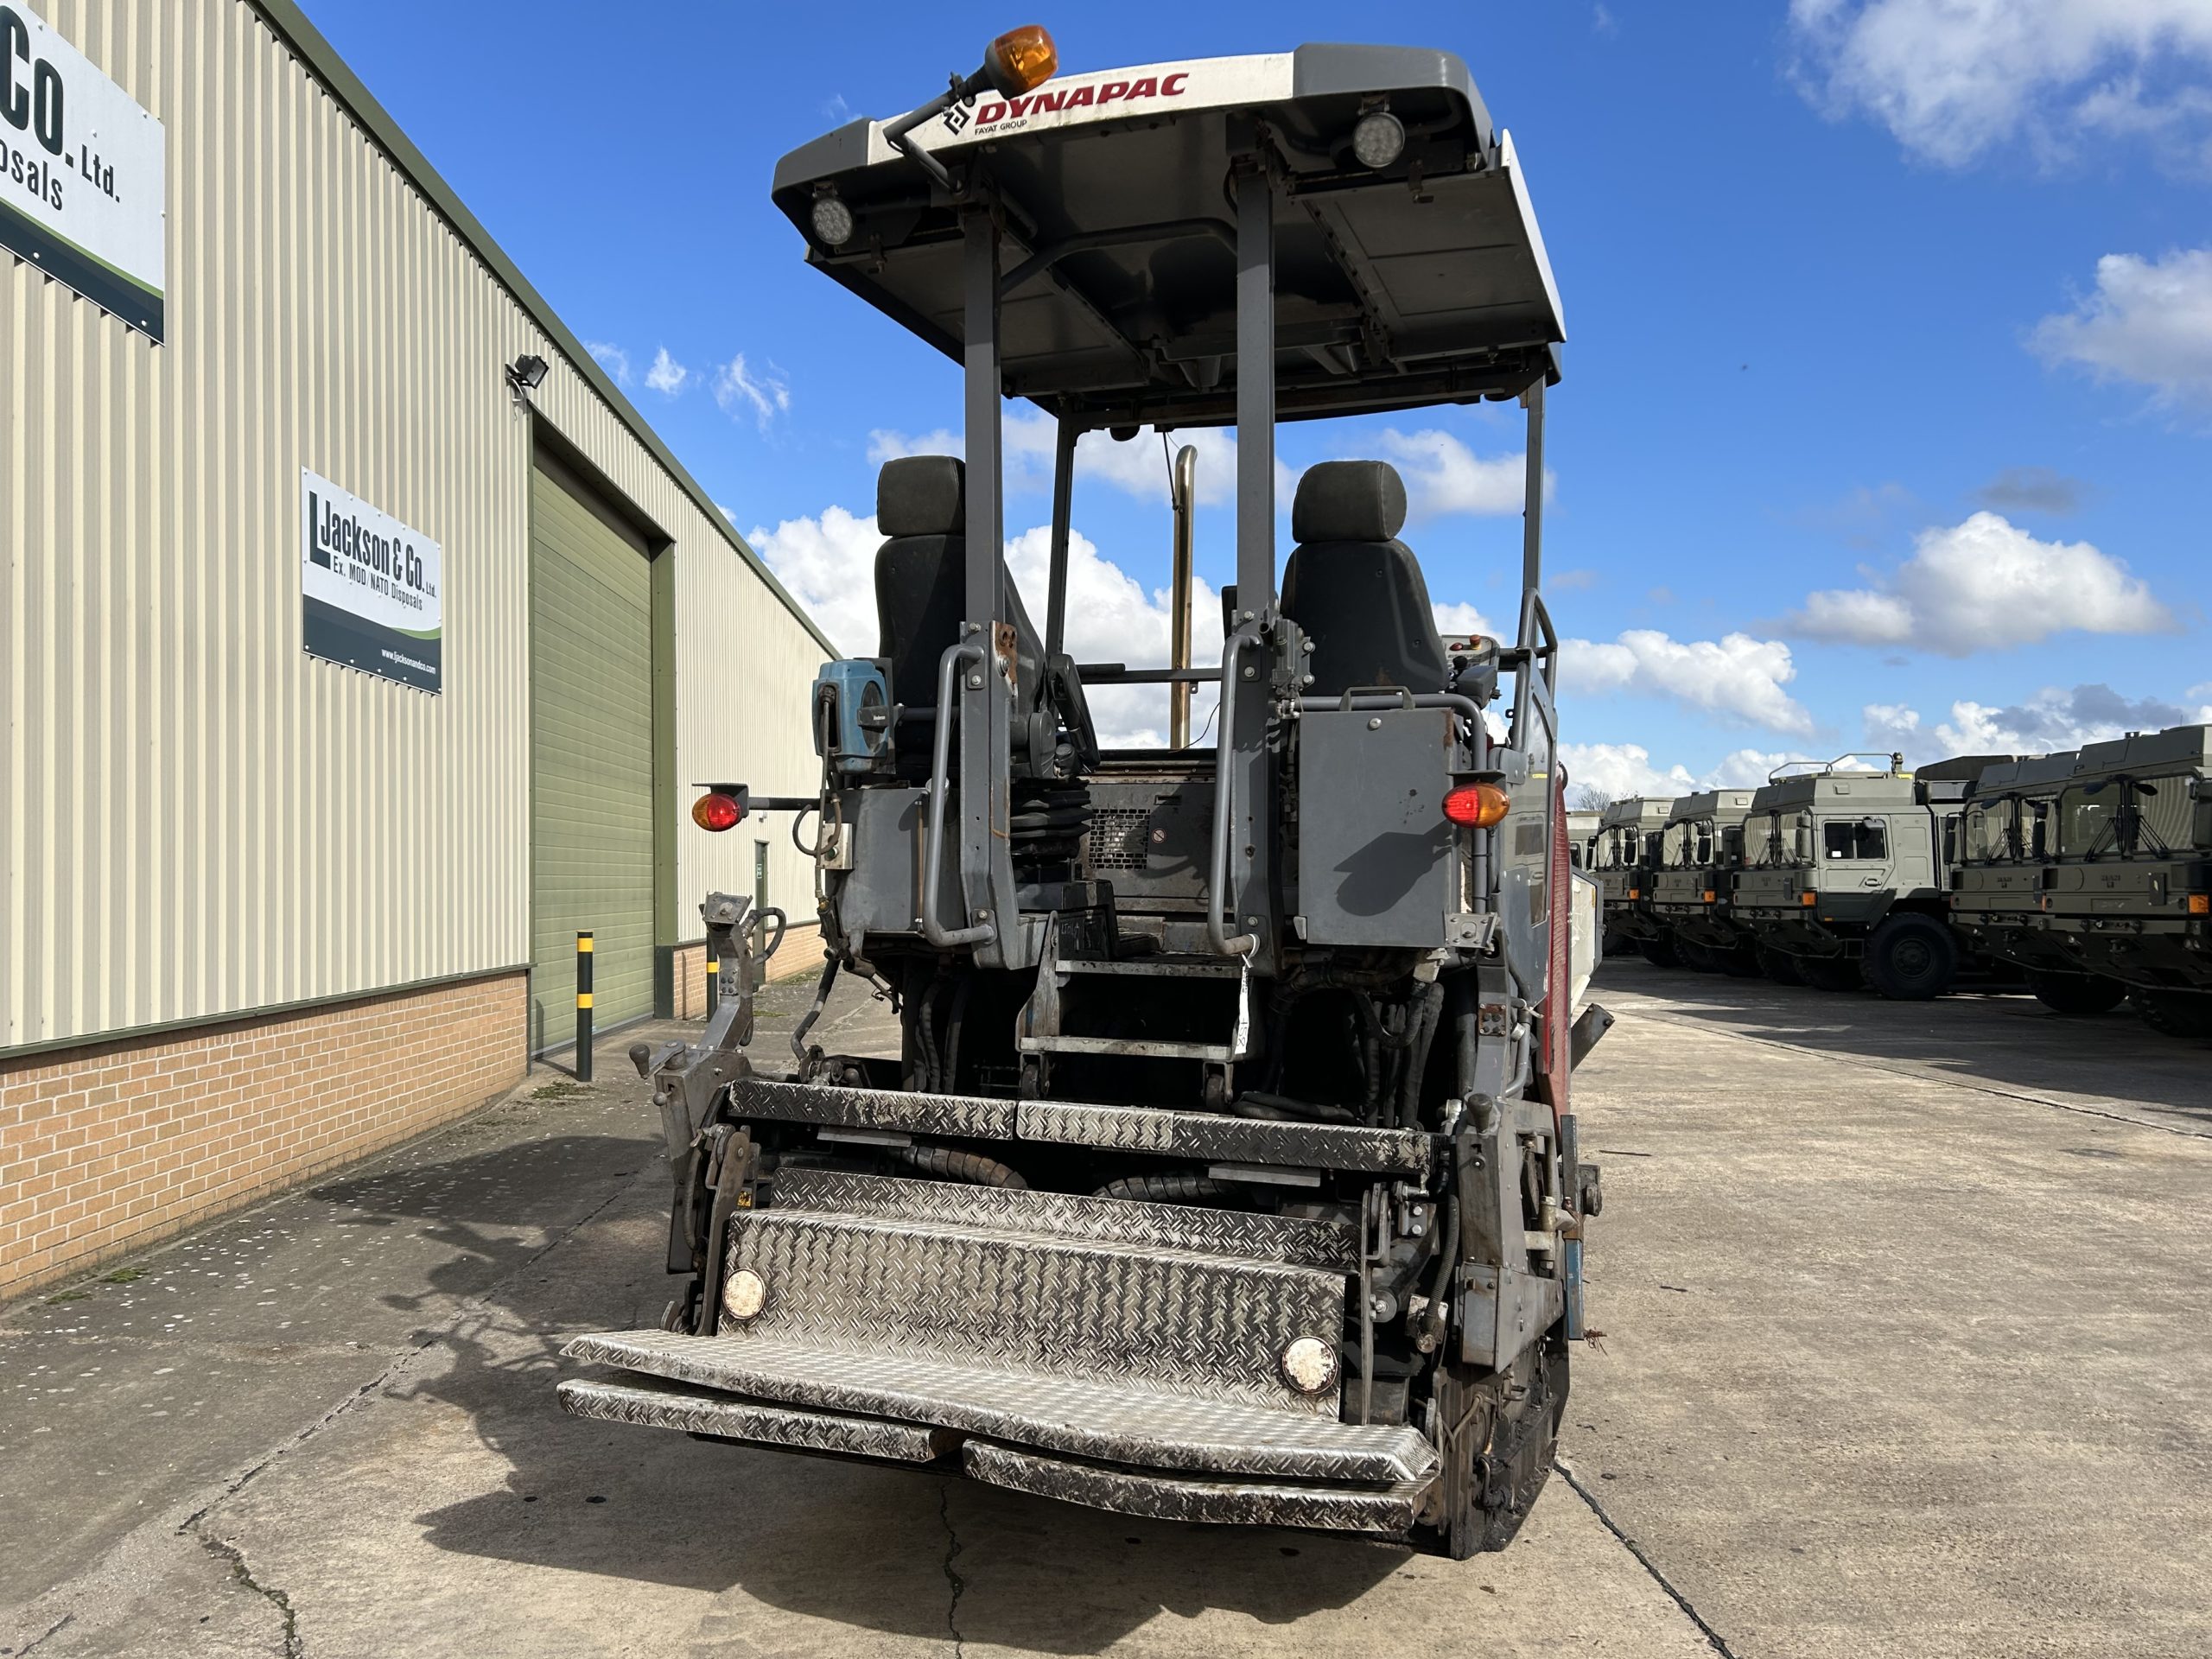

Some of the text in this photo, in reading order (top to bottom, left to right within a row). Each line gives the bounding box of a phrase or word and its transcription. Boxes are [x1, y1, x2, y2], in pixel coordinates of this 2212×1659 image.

[0, 4, 120, 203] Co. Ltd.
[975, 73, 1189, 125] DYNAPAC
[975, 119, 1027, 135] FAYAT GROUP
[334, 555, 346, 577] Ex.
[391, 582, 423, 611] Disposals
[393, 537, 403, 581] &
[406, 543, 424, 593] Co.
[426, 581, 436, 599] Ltd.
